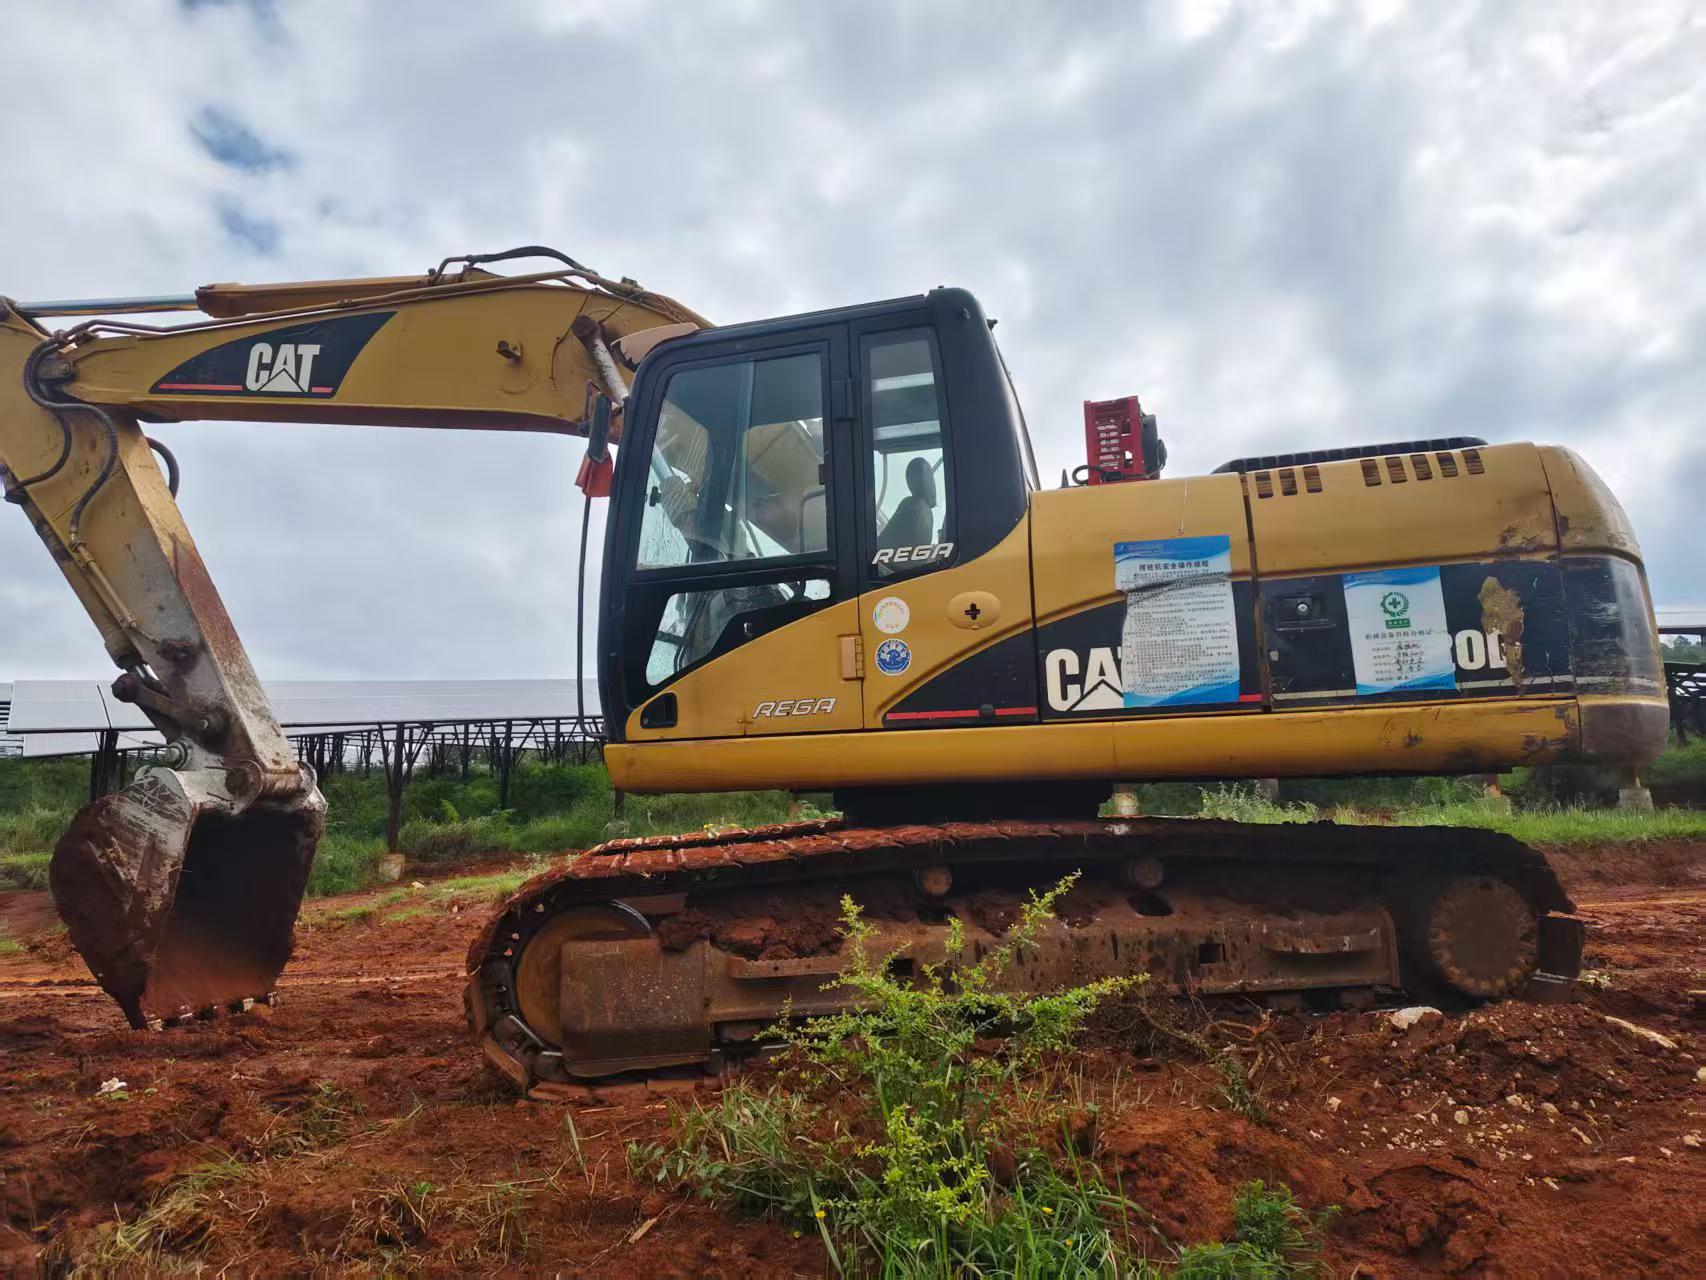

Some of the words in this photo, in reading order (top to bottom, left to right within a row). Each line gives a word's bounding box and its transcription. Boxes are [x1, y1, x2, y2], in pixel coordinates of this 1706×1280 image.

[246, 342, 320, 392] CAT
[872, 543, 954, 565] REGA
[1045, 646, 1124, 712] CA
[752, 698, 836, 718] REGA
